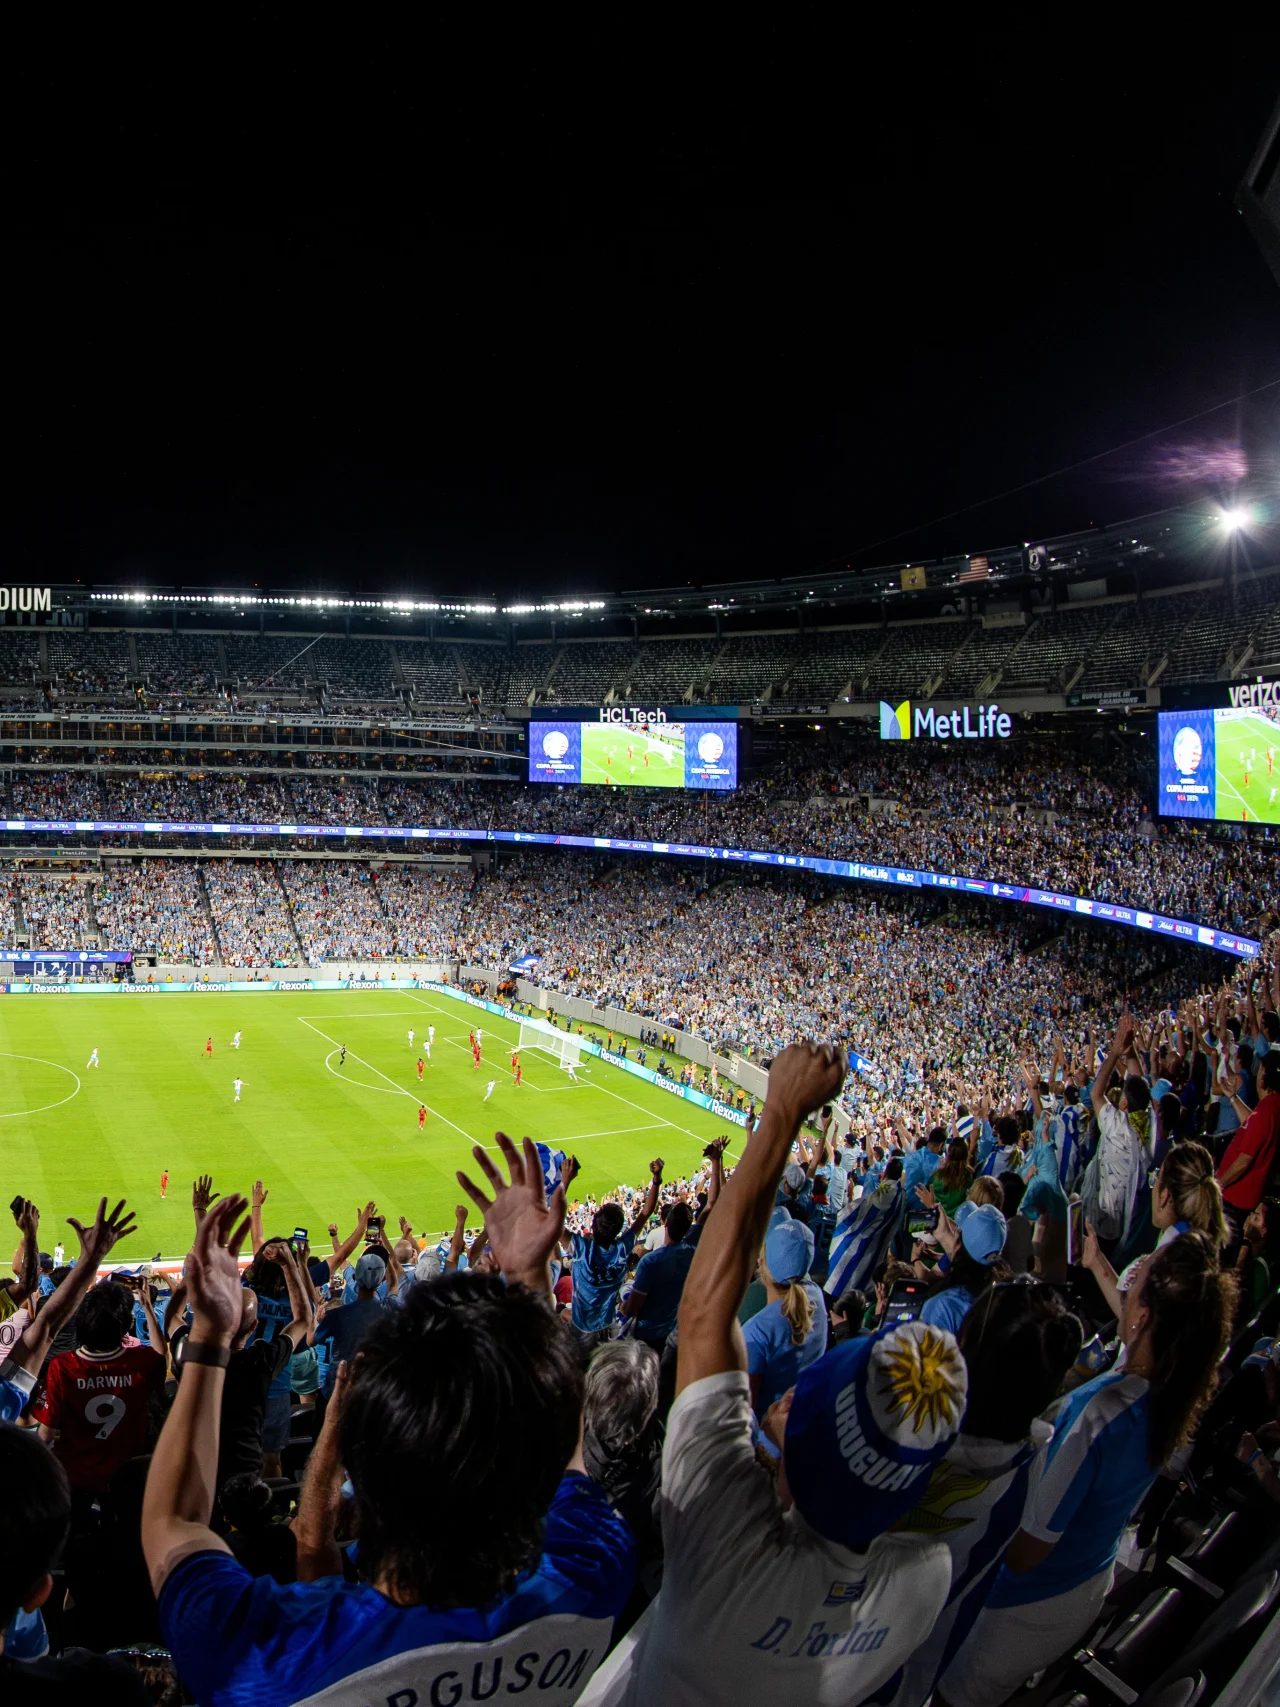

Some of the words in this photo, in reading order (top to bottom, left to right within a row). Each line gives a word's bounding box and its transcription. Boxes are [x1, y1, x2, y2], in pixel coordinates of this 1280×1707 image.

[600, 708, 666, 722] HCLTech
[914, 705, 1012, 738] MetLife
[860, 866, 888, 880] MetLife
[1056, 896, 1070, 906] ULTRA
[1116, 909, 1131, 920] ULTRA
[1176, 924, 1192, 936] ULTRA
[1238, 942, 1254, 954] ULTRA
[33, 984, 70, 993] Rexona
[122, 983, 159, 992] Rexona
[194, 983, 230, 991] Rexona
[279, 981, 313, 990] Rexona
[350, 980, 382, 989] Rexona
[420, 981, 445, 994] Rexona
[466, 996, 486, 1010] Rexona
[600, 1048, 626, 1069] Rexona
[655, 1073, 685, 1097] Rexona
[712, 1099, 745, 1126] Rexona
[77, 1374, 132, 1390] DARWIN
[84, 1394, 126, 1439] 9
[835, 1381, 932, 1492] URUGUAY
[790, 1618, 890, 1657] Forlán
